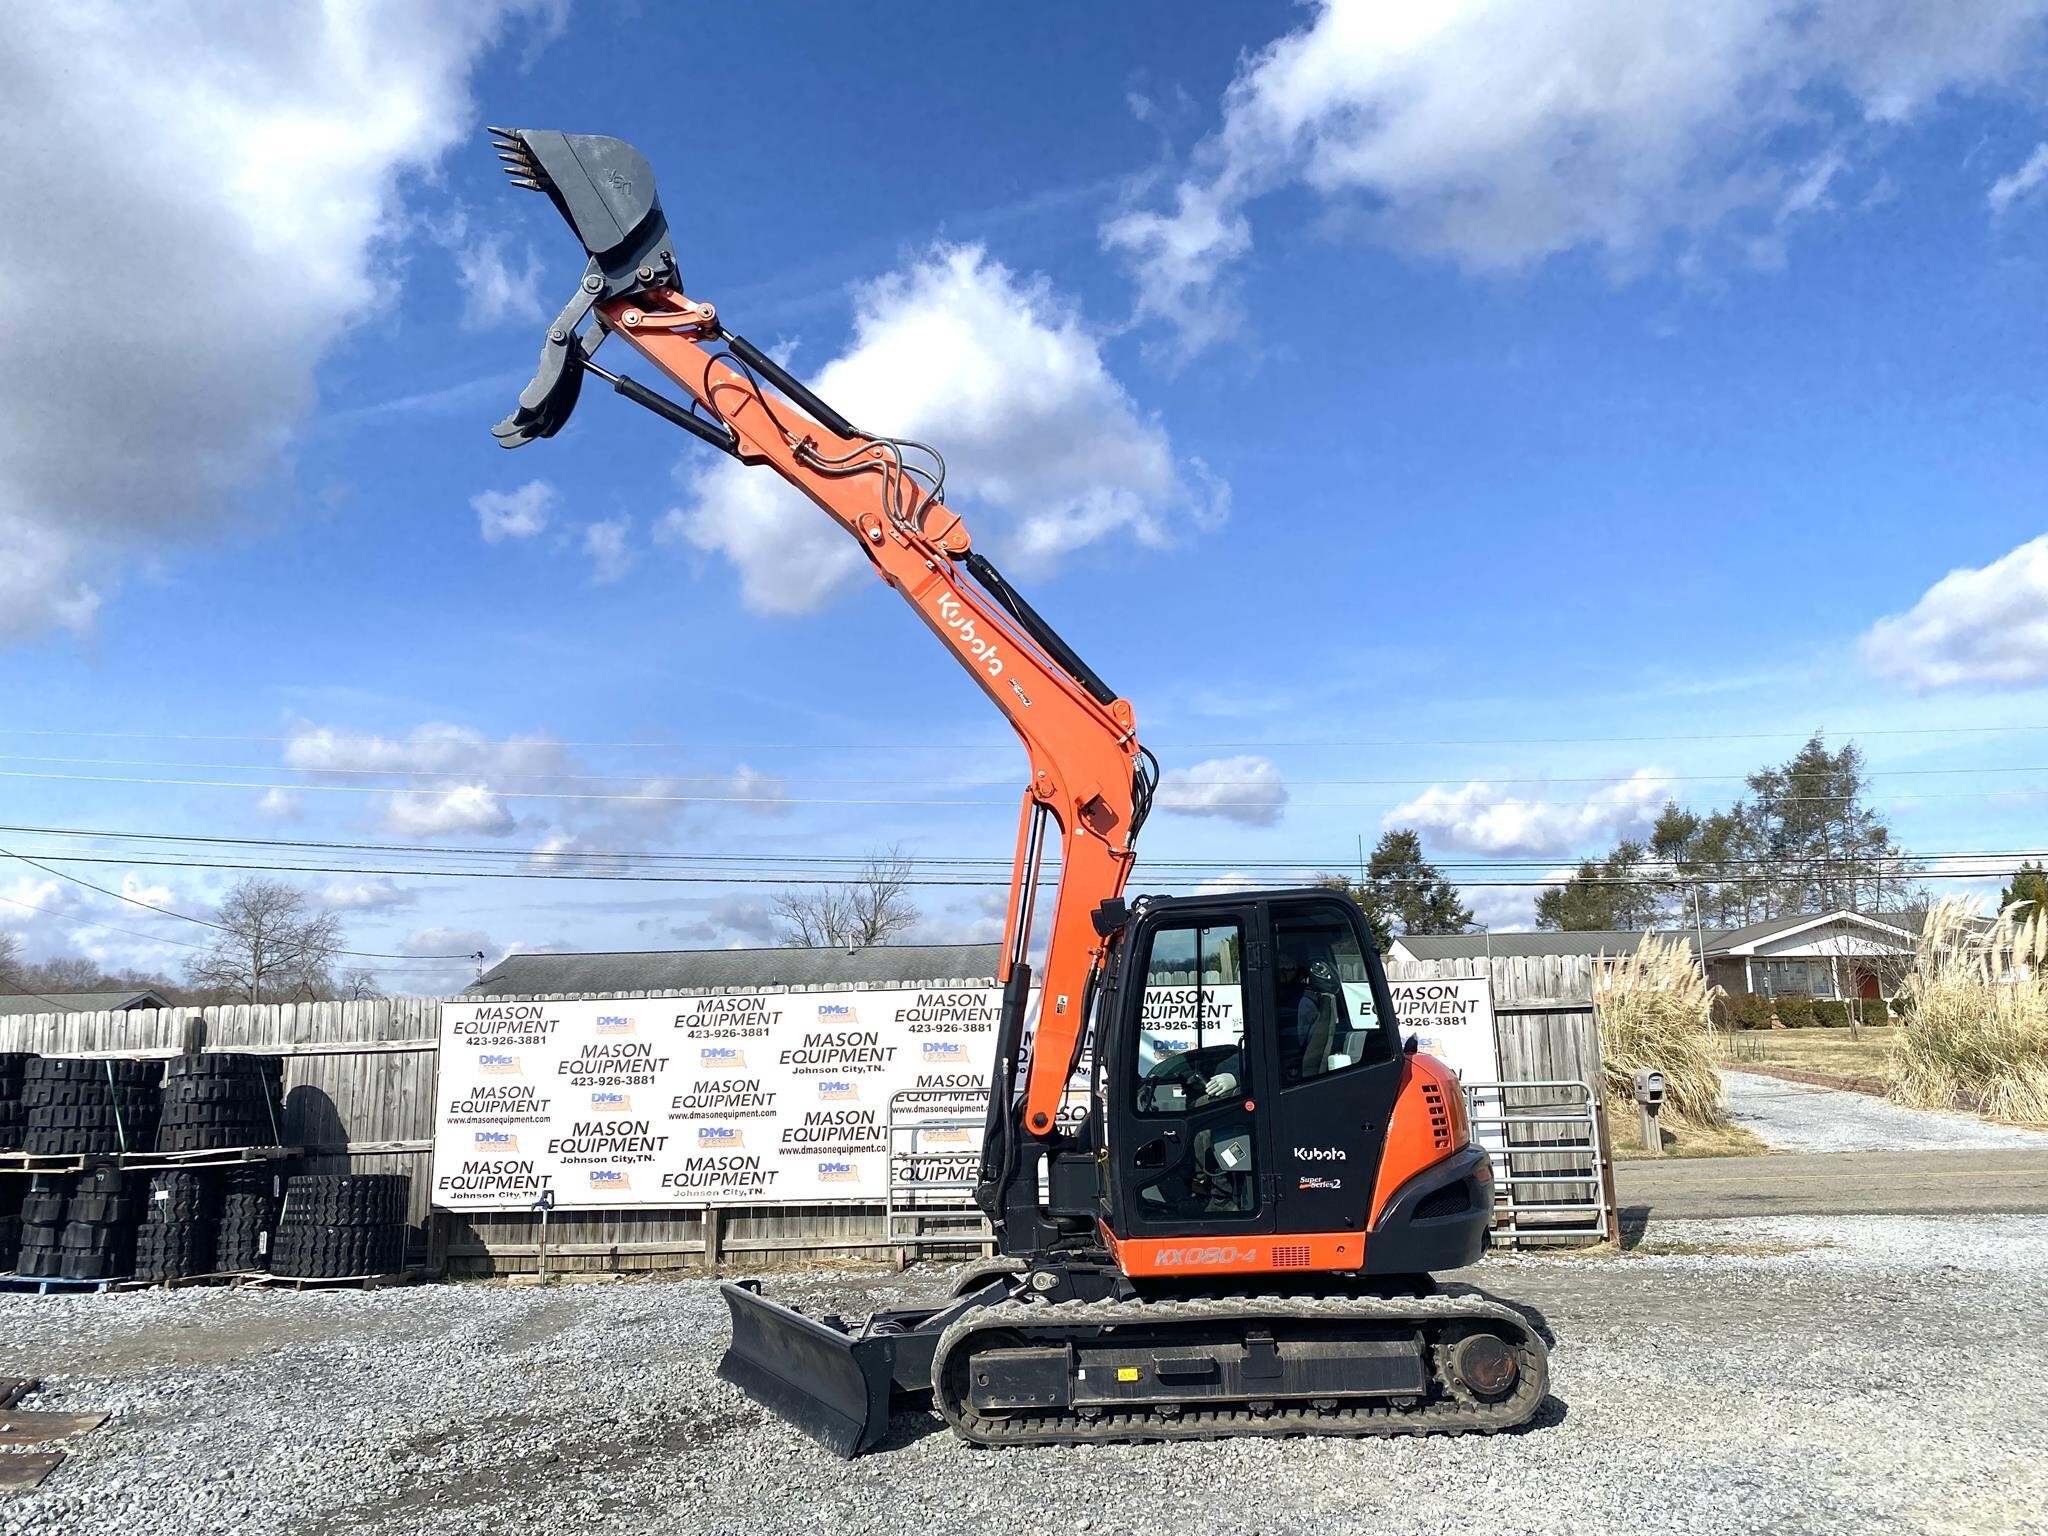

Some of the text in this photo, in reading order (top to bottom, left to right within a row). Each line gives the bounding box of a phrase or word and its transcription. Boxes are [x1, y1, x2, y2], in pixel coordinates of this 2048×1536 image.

[937, 592, 1003, 677] Kubota
[916, 993, 986, 1007] MASON
[1145, 990, 1214, 1004] MASON
[696, 998, 765, 1012] MASON
[1142, 1005, 1232, 1019] QUIPMENT
[1360, 1000, 1479, 1015] EUIPMENT
[475, 1007, 543, 1019] MASON
[674, 1011, 782, 1028] EQUIPMENT
[895, 1007, 1002, 1022] EQUIPMENT
[453, 1020, 559, 1035] EQUIPMENT
[909, 1024, 992, 1033] 423-926-3881
[1376, 1017, 1467, 1026] 3-926-3881
[466, 1036, 547, 1045] 423-926-3881
[688, 1028, 769, 1039] 423-926-3881
[803, 1032, 878, 1048] MASON
[581, 1043, 652, 1058] MASON
[779, 1047, 897, 1065] EQUIPMENT
[558, 1058, 669, 1074] EQUIPMENT
[792, 1066, 838, 1074] Johnson
[571, 1076, 655, 1086] 423-926-3881
[692, 1079, 759, 1093] MASON
[916, 1075, 984, 1088] MASON
[470, 1086, 535, 1099] MASON
[895, 1092, 990, 1102] EQUIPMEN
[450, 1100, 550, 1113] EQUIPMENT
[671, 1093, 776, 1108] EQUIPMENT
[668, 1109, 776, 1120] www.dmasonequipment.com
[892, 1105, 988, 1114] www.dmasonequipment.
[447, 1114, 550, 1124] www.dmasonequipment.com
[804, 1110, 875, 1125] MASON
[572, 1121, 649, 1137] MASON
[782, 1126, 888, 1142] EQUIPMENT
[548, 1137, 668, 1153] EQUIPMENT
[779, 1145, 886, 1155] www.dmasonequipment.co
[560, 1156, 607, 1164] Johnson
[1293, 1147, 1346, 1161] Kubota
[462, 1161, 534, 1174] MASON
[684, 1156, 760, 1171] MASON
[661, 1171, 778, 1188] EQUIPMENT
[892, 1167, 977, 1180] EQUIPME
[439, 1175, 551, 1190] EQUIPMENT
[673, 1189, 719, 1197] Johnson
[1153, 1247, 1257, 1266] KX080-4
